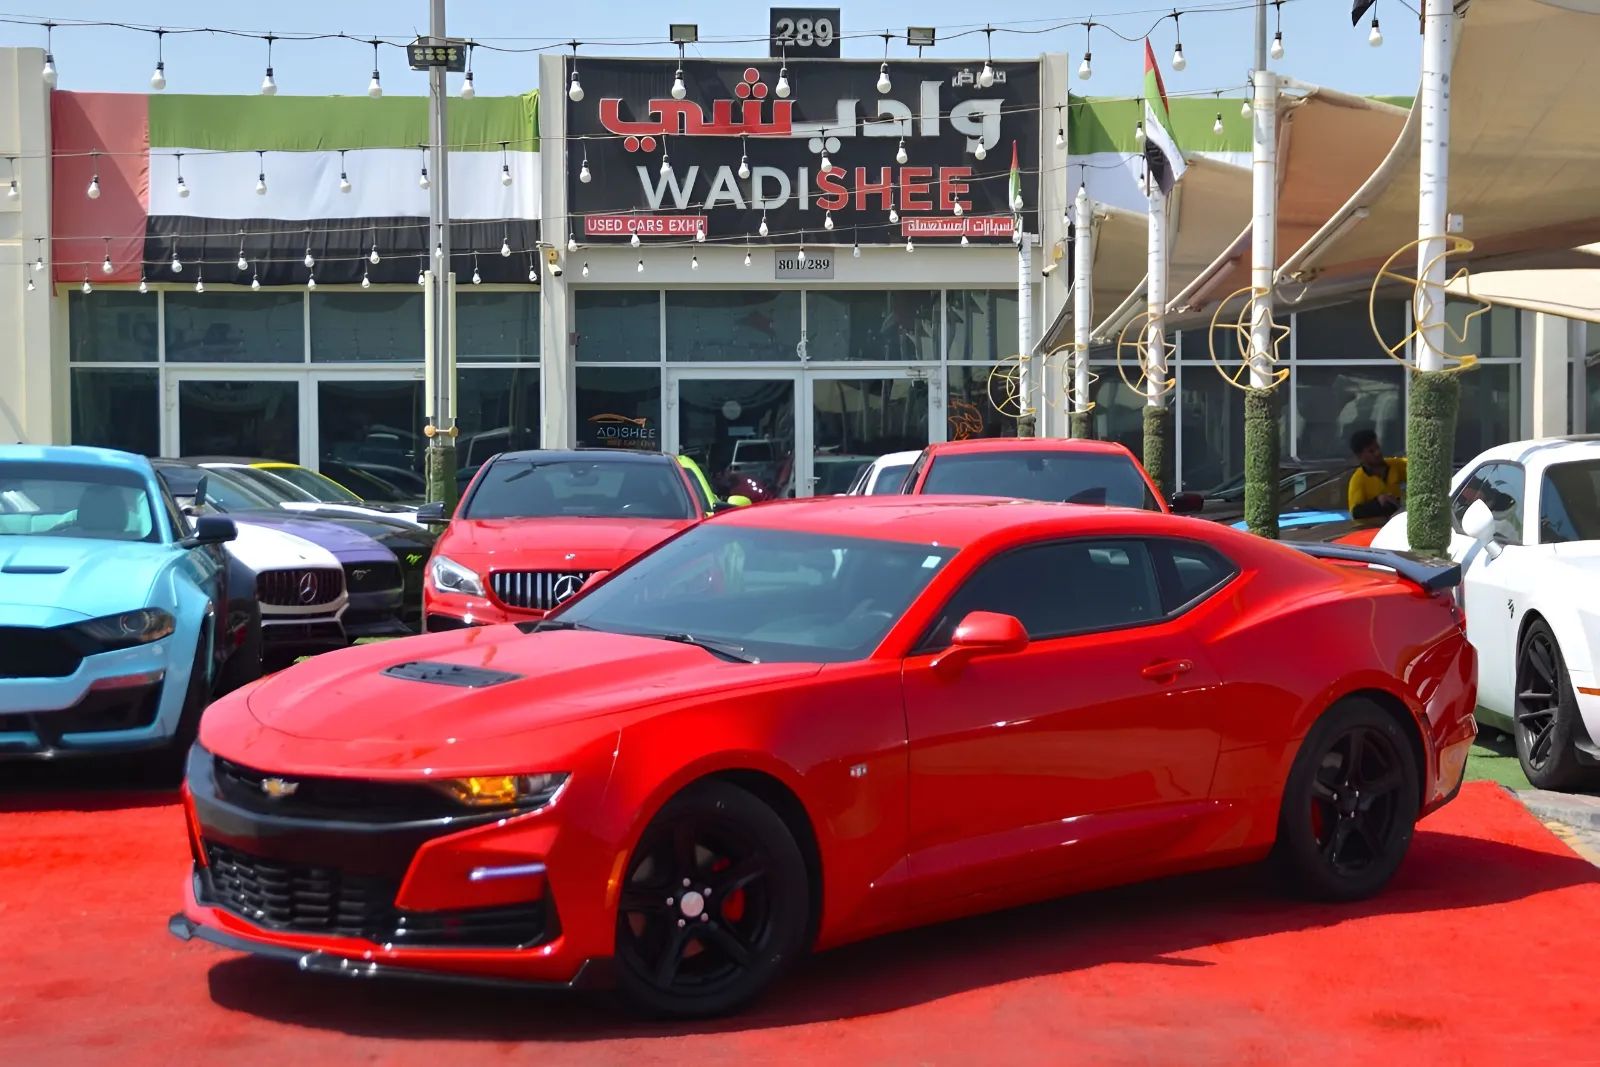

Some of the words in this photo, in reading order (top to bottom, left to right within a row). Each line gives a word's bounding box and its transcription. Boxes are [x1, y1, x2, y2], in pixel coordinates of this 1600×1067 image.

[775, 17, 833, 47] 289
[588, 219, 623, 232] USED
[627, 219, 664, 232] CARS
